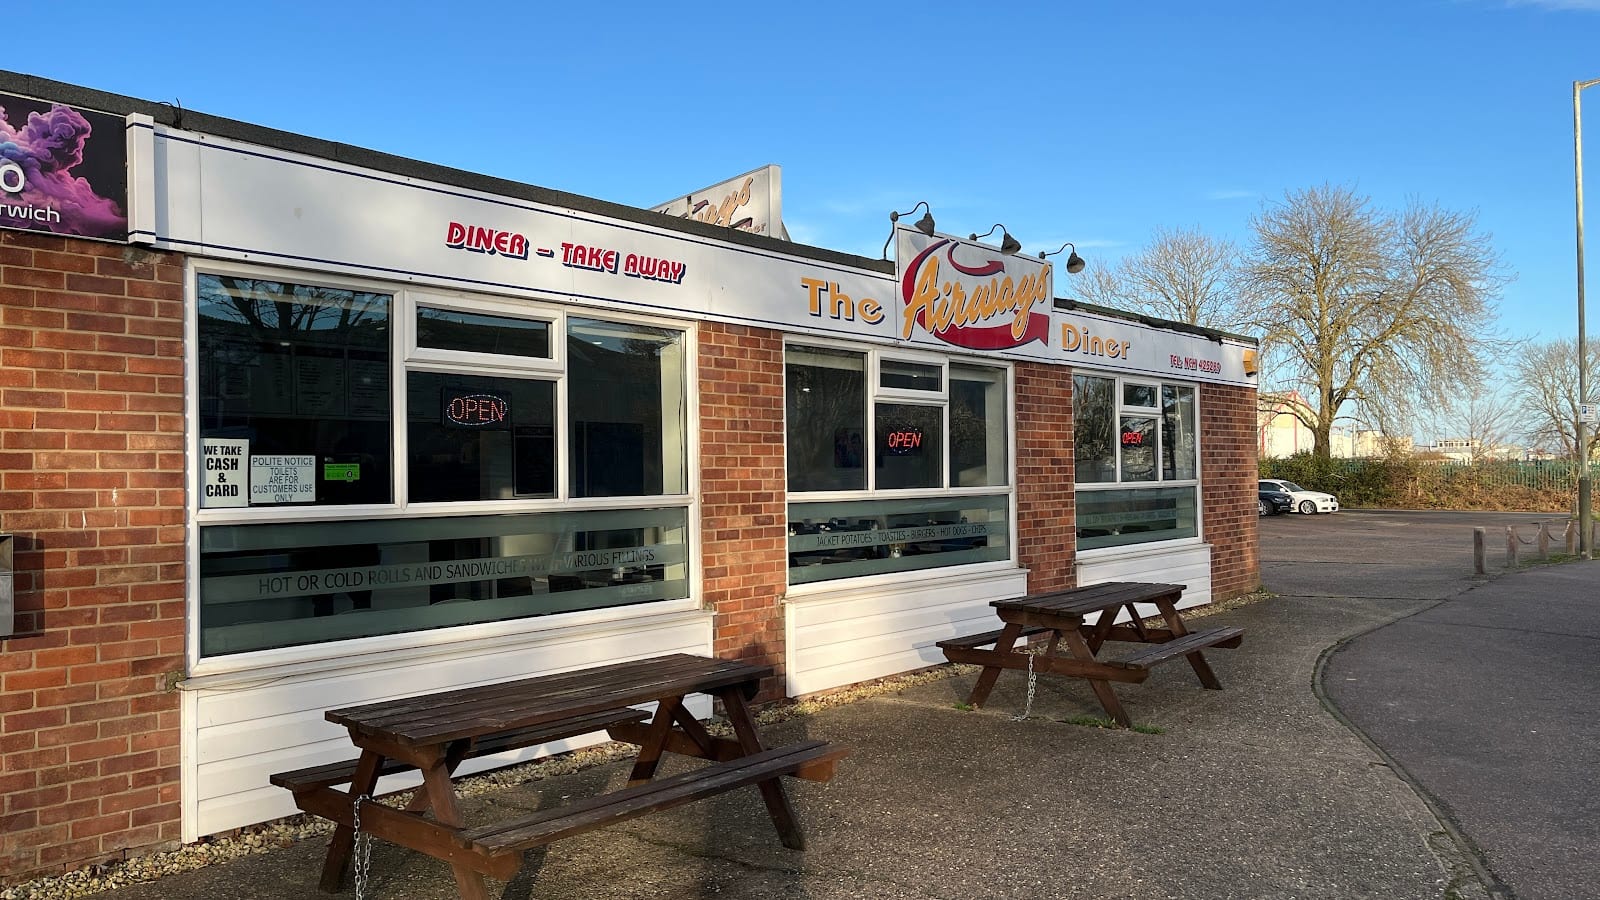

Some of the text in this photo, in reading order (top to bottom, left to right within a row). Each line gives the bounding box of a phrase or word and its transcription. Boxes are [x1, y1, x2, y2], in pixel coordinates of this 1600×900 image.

[446, 221, 530, 261] DINER
[561, 242, 620, 275] TAKE
[624, 253, 686, 285] AWAY
[801, 255, 1131, 360] The Airways Diner
[451, 397, 504, 422] OPEN
[888, 431, 922, 448] OPEN
[1122, 431, 1143, 444] OPEN
[203, 445, 242, 456] WE TAKE
[206, 457, 239, 471] CASH
[252, 457, 313, 466] POLITE NOTICE
[217, 472, 227, 483] &
[270, 467, 298, 476] TOILETS
[268, 476, 299, 485] ARE FOR
[206, 484, 239, 497] CARD
[252, 484, 313, 494] CUSTOMERS USE
[274, 493, 293, 502] ONLY
[816, 534, 839, 546] JACKET
[841, 532, 873, 545] POTATOES
[878, 530, 906, 542] TOASTIES
[911, 528, 936, 540] BURGERS
[940, 527, 951, 537] HOT
[952, 526, 967, 536] DOGS
[971, 524, 987, 535] CHIPS
[259, 576, 293, 595] HOT
[297, 574, 320, 591] OR
[324, 571, 364, 589] COLD
[368, 566, 411, 585] ROLLS
[414, 565, 442, 582] AND
[563, 551, 609, 568] VARIOUS
[612, 549, 655, 564] FILLINGS
